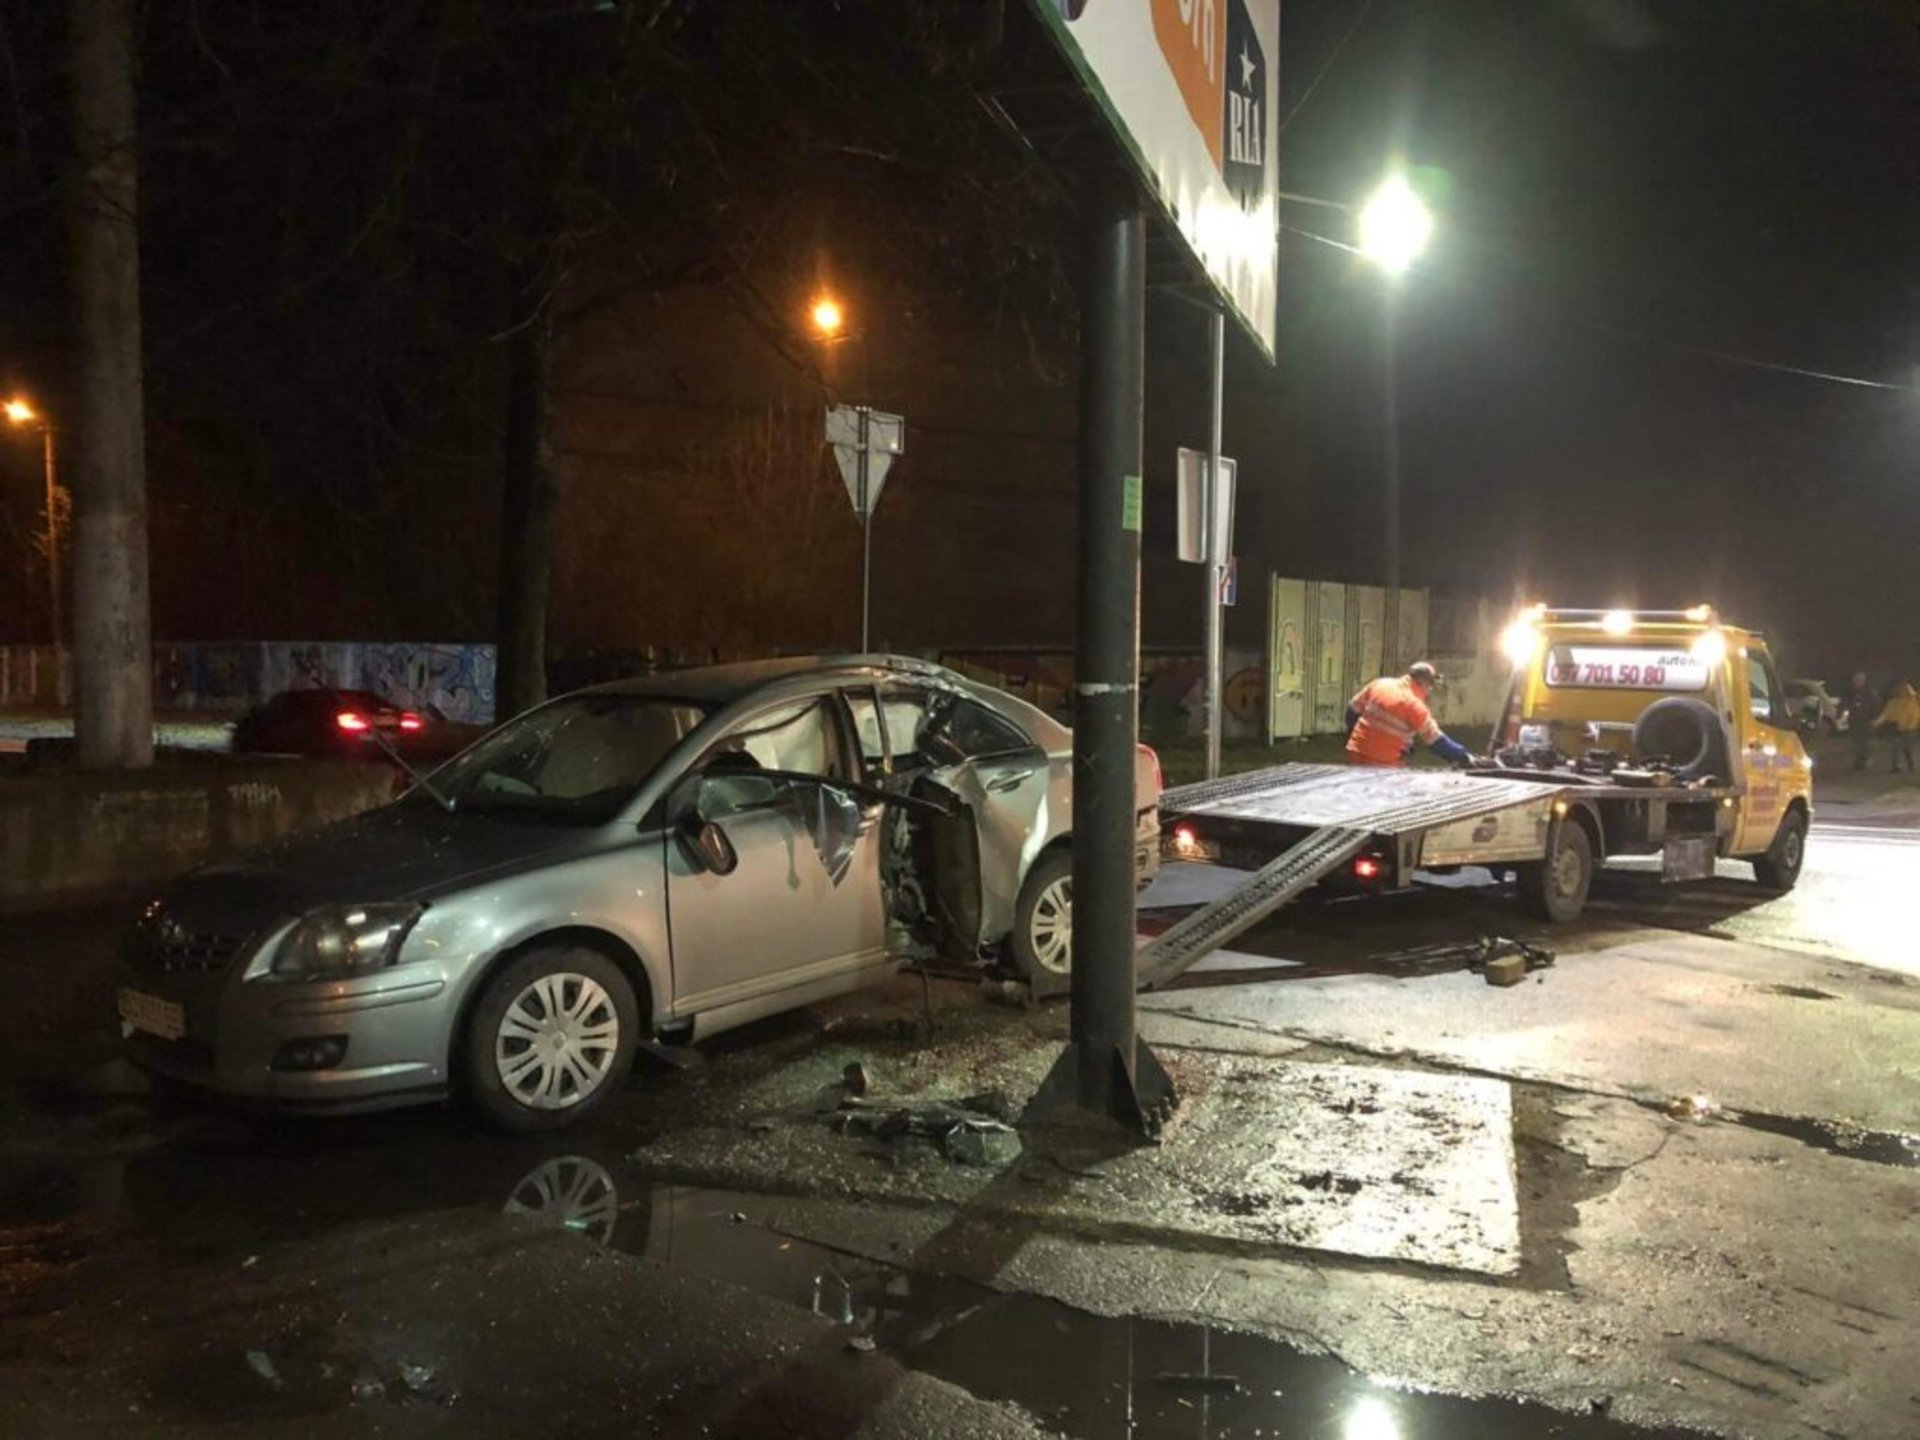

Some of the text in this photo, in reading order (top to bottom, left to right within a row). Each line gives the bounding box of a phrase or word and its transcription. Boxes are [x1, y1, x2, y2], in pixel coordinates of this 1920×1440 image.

[1229, 89, 1263, 166] RIA
[1584, 663, 1614, 684] 701
[1618, 664, 1640, 685] 50
[1643, 665, 1667, 686] 80
